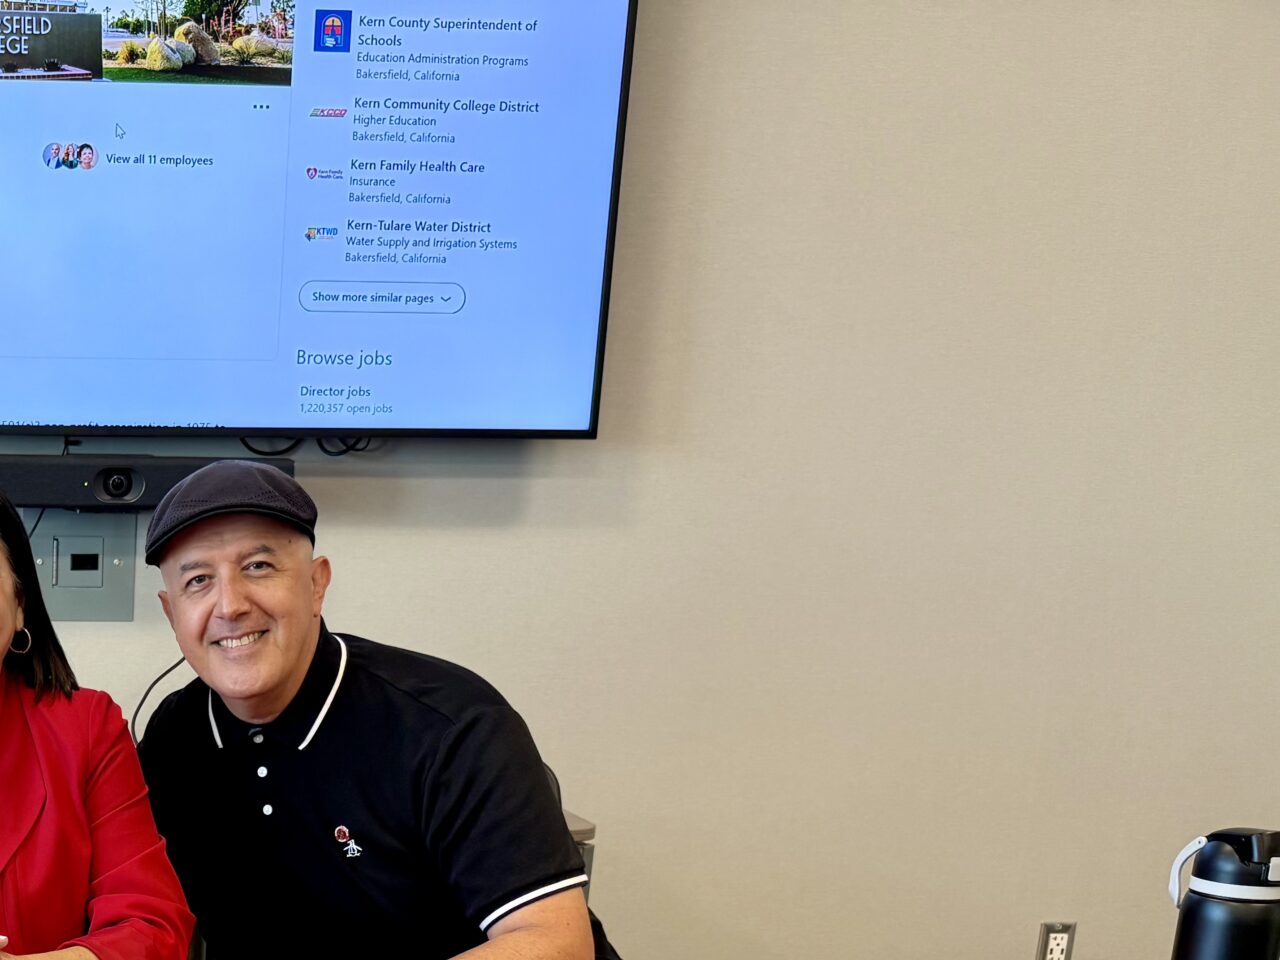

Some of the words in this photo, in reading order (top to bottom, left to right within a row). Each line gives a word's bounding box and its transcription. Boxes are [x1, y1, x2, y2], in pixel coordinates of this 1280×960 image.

[359, 16, 385, 28] Kern
[388, 17, 430, 32] County
[434, 18, 522, 32] Superintendent
[525, 20, 538, 31] of
[358, 34, 402, 47] Schools
[357, 52, 405, 64] Education
[408, 54, 480, 65] Administration
[482, 56, 529, 68] Programs
[356, 69, 411, 81] Bakersfield,
[414, 70, 460, 81] California
[354, 98, 380, 110] Kern
[384, 99, 451, 113] Community
[454, 100, 496, 114] College
[499, 101, 539, 113] District
[353, 115, 386, 128] Higher
[388, 116, 437, 126] Education
[352, 132, 407, 143] Bakersfield,
[410, 132, 455, 143] California
[106, 154, 130, 165] View
[133, 154, 145, 165] all
[148, 155, 157, 165] 11
[160, 155, 214, 167] employees
[350, 160, 376, 171] Kern
[380, 160, 417, 174] Family
[420, 161, 457, 172] Health
[460, 162, 485, 173] Care
[350, 176, 396, 187] Insurance
[348, 193, 403, 204] Bakersfield,
[406, 194, 451, 204] California
[346, 220, 412, 231] Kern-Tulare
[415, 221, 449, 232] Water
[452, 222, 491, 233] District
[346, 237, 375, 247] Water
[377, 238, 410, 250] Supply
[412, 238, 431, 248] and
[433, 238, 477, 250] Irrigation
[479, 239, 518, 250] Systems
[345, 253, 399, 264] Bakersfield,
[402, 254, 447, 264] California
[312, 292, 340, 302] Show
[342, 294, 367, 302] more
[370, 293, 402, 303] similar
[405, 294, 434, 305] pages
[296, 350, 354, 365] Browse
[357, 352, 392, 369] jobs
[300, 386, 344, 397] Director
[346, 387, 371, 399] jobs
[300, 403, 344, 414] 1,220,357
[346, 405, 370, 415] open
[372, 404, 393, 415] jobs
